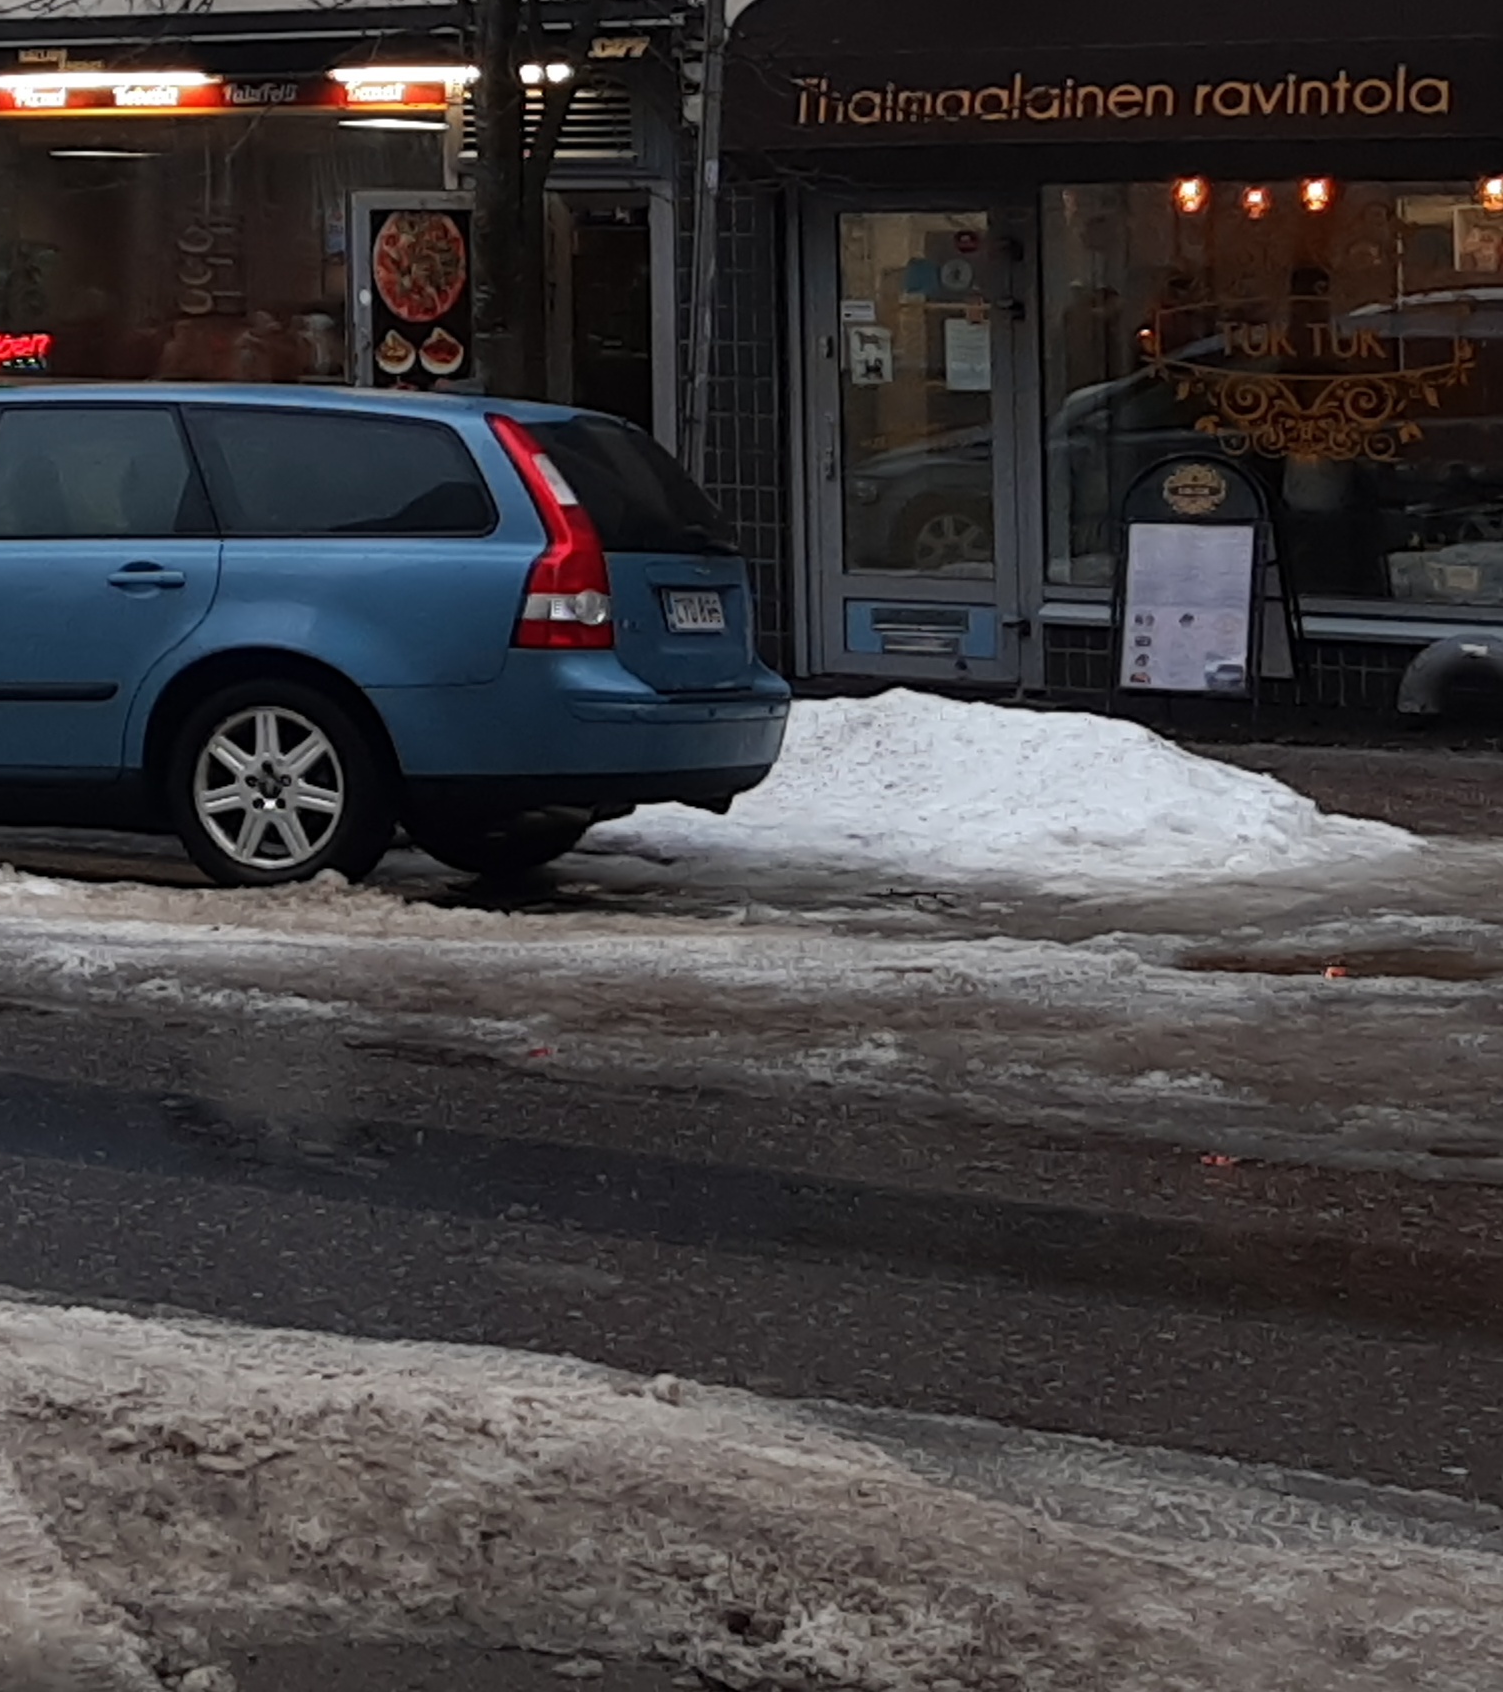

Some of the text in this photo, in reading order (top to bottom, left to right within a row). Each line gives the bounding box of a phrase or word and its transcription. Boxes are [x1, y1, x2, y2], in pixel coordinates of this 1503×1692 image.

[791, 63, 1450, 124] Thaimaalainen ravintola
[1216, 320, 1387, 359] TUK TUK
